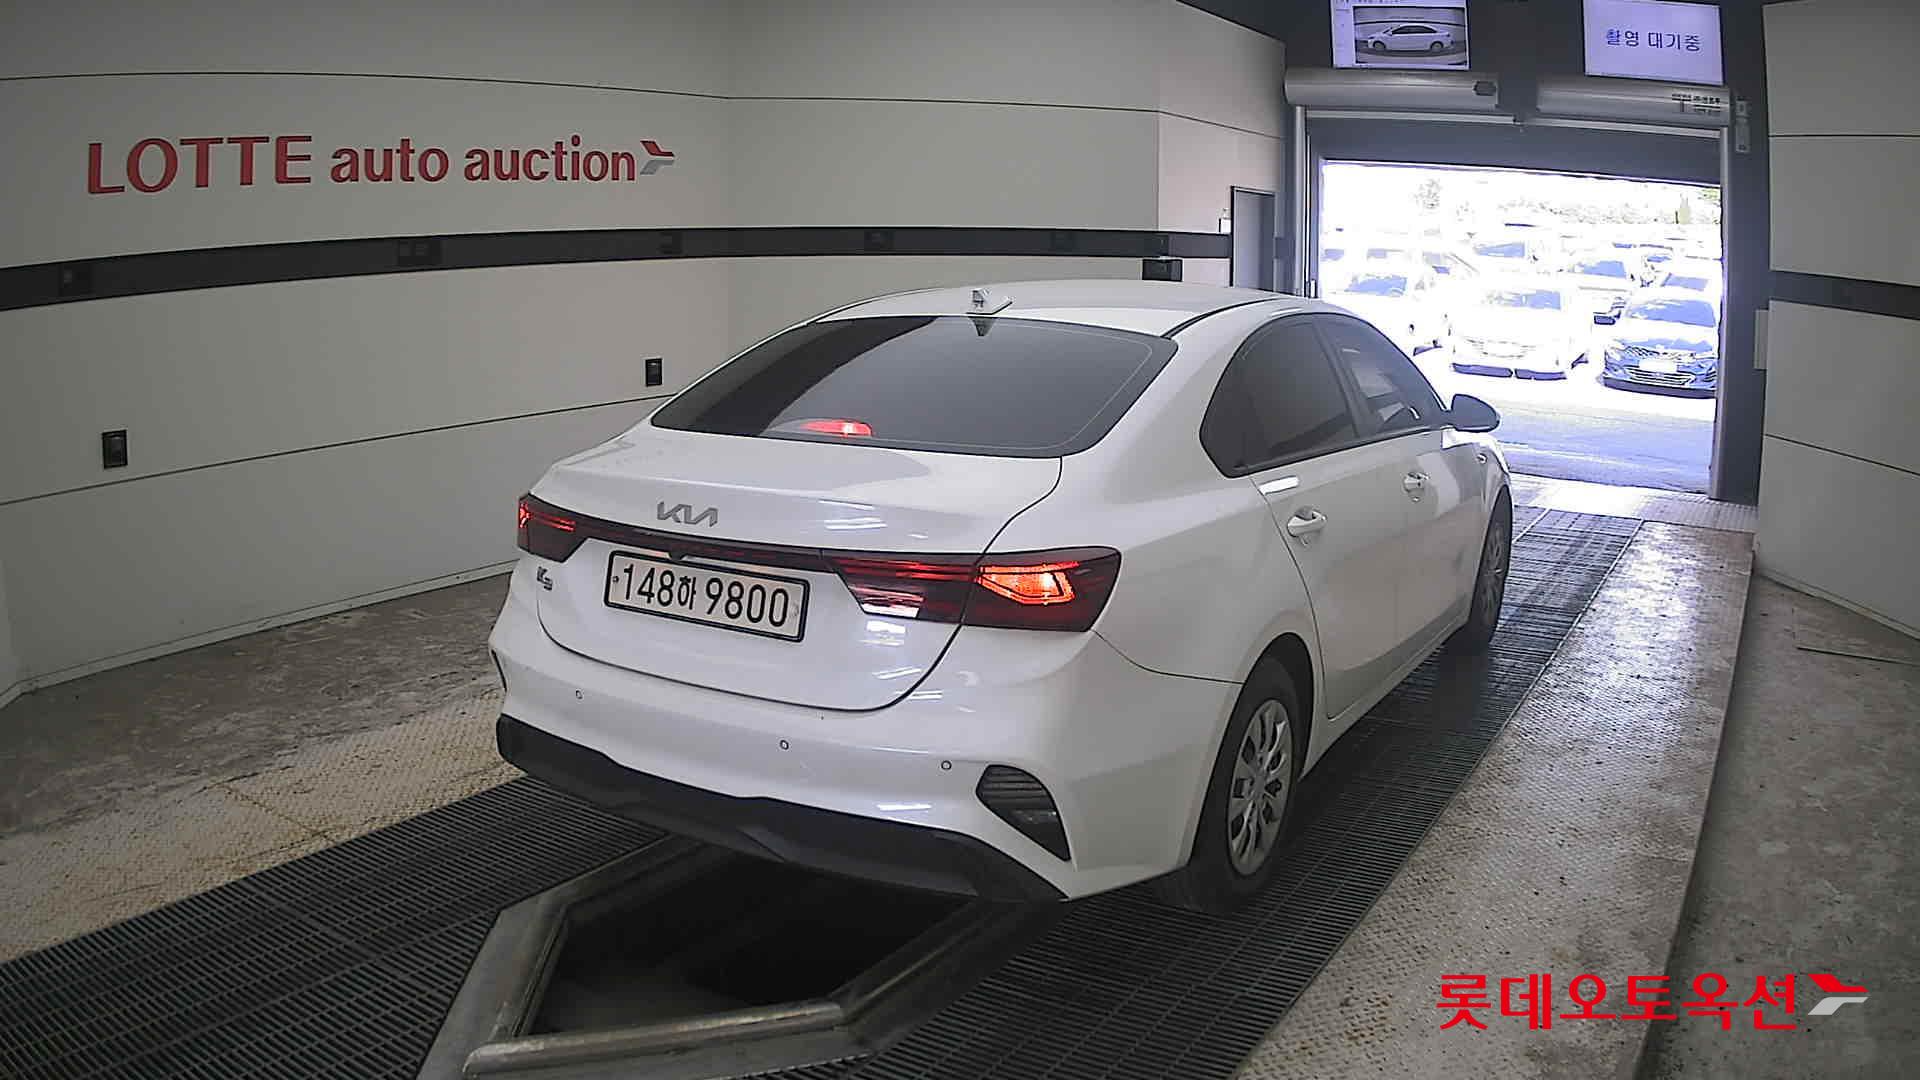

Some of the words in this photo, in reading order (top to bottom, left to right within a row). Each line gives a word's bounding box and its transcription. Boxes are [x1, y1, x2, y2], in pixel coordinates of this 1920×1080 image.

[1606, 28, 1639, 47] 촬영
[1648, 32, 1700, 52] 대기중
[87, 135, 312, 194] LOTTE
[330, 137, 449, 183] auto
[463, 134, 636, 182] auction
[657, 501, 719, 528] KIA
[623, 563, 698, 611] 148하
[705, 577, 790, 628] 9800
